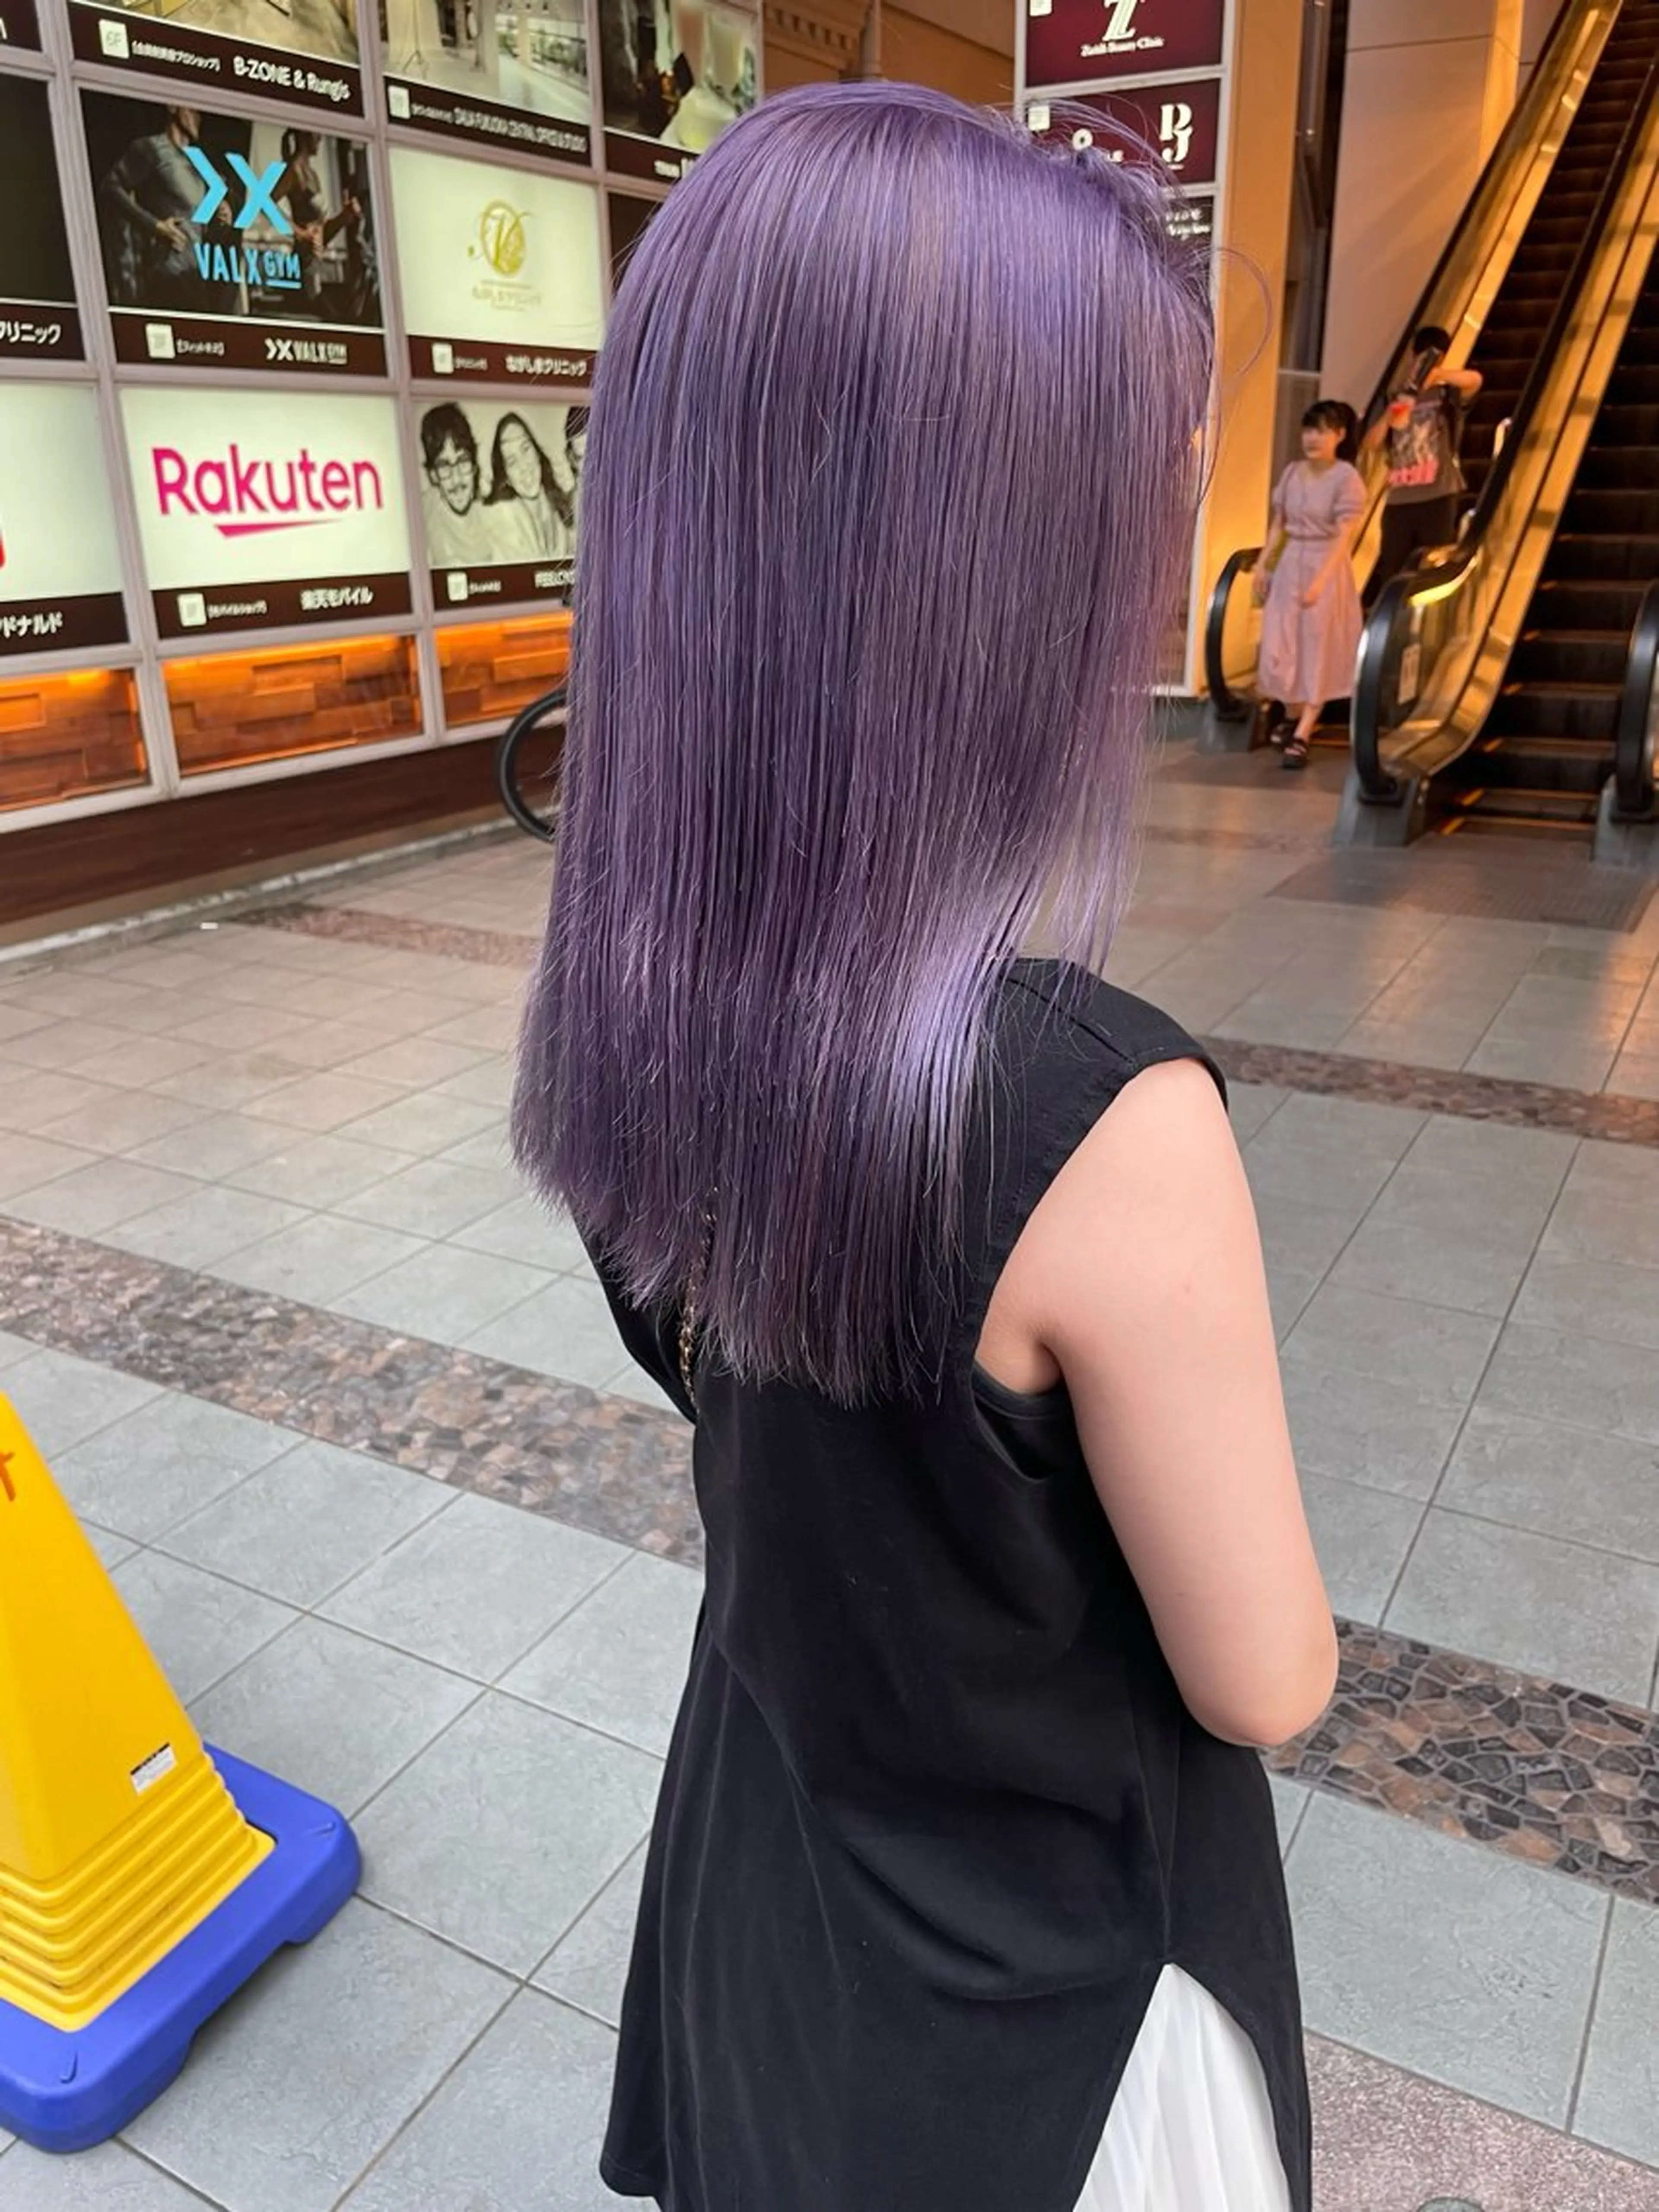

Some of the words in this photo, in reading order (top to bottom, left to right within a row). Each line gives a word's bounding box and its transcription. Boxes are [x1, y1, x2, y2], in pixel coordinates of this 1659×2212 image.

[233, 56, 292, 86] B-ZONE
[293, 69, 305, 89] &
[194, 242, 262, 286] VALX
[263, 249, 302, 280] GYM
[152, 443, 383, 515] Rakuten
[0, 610, 64, 639] ドナルド
